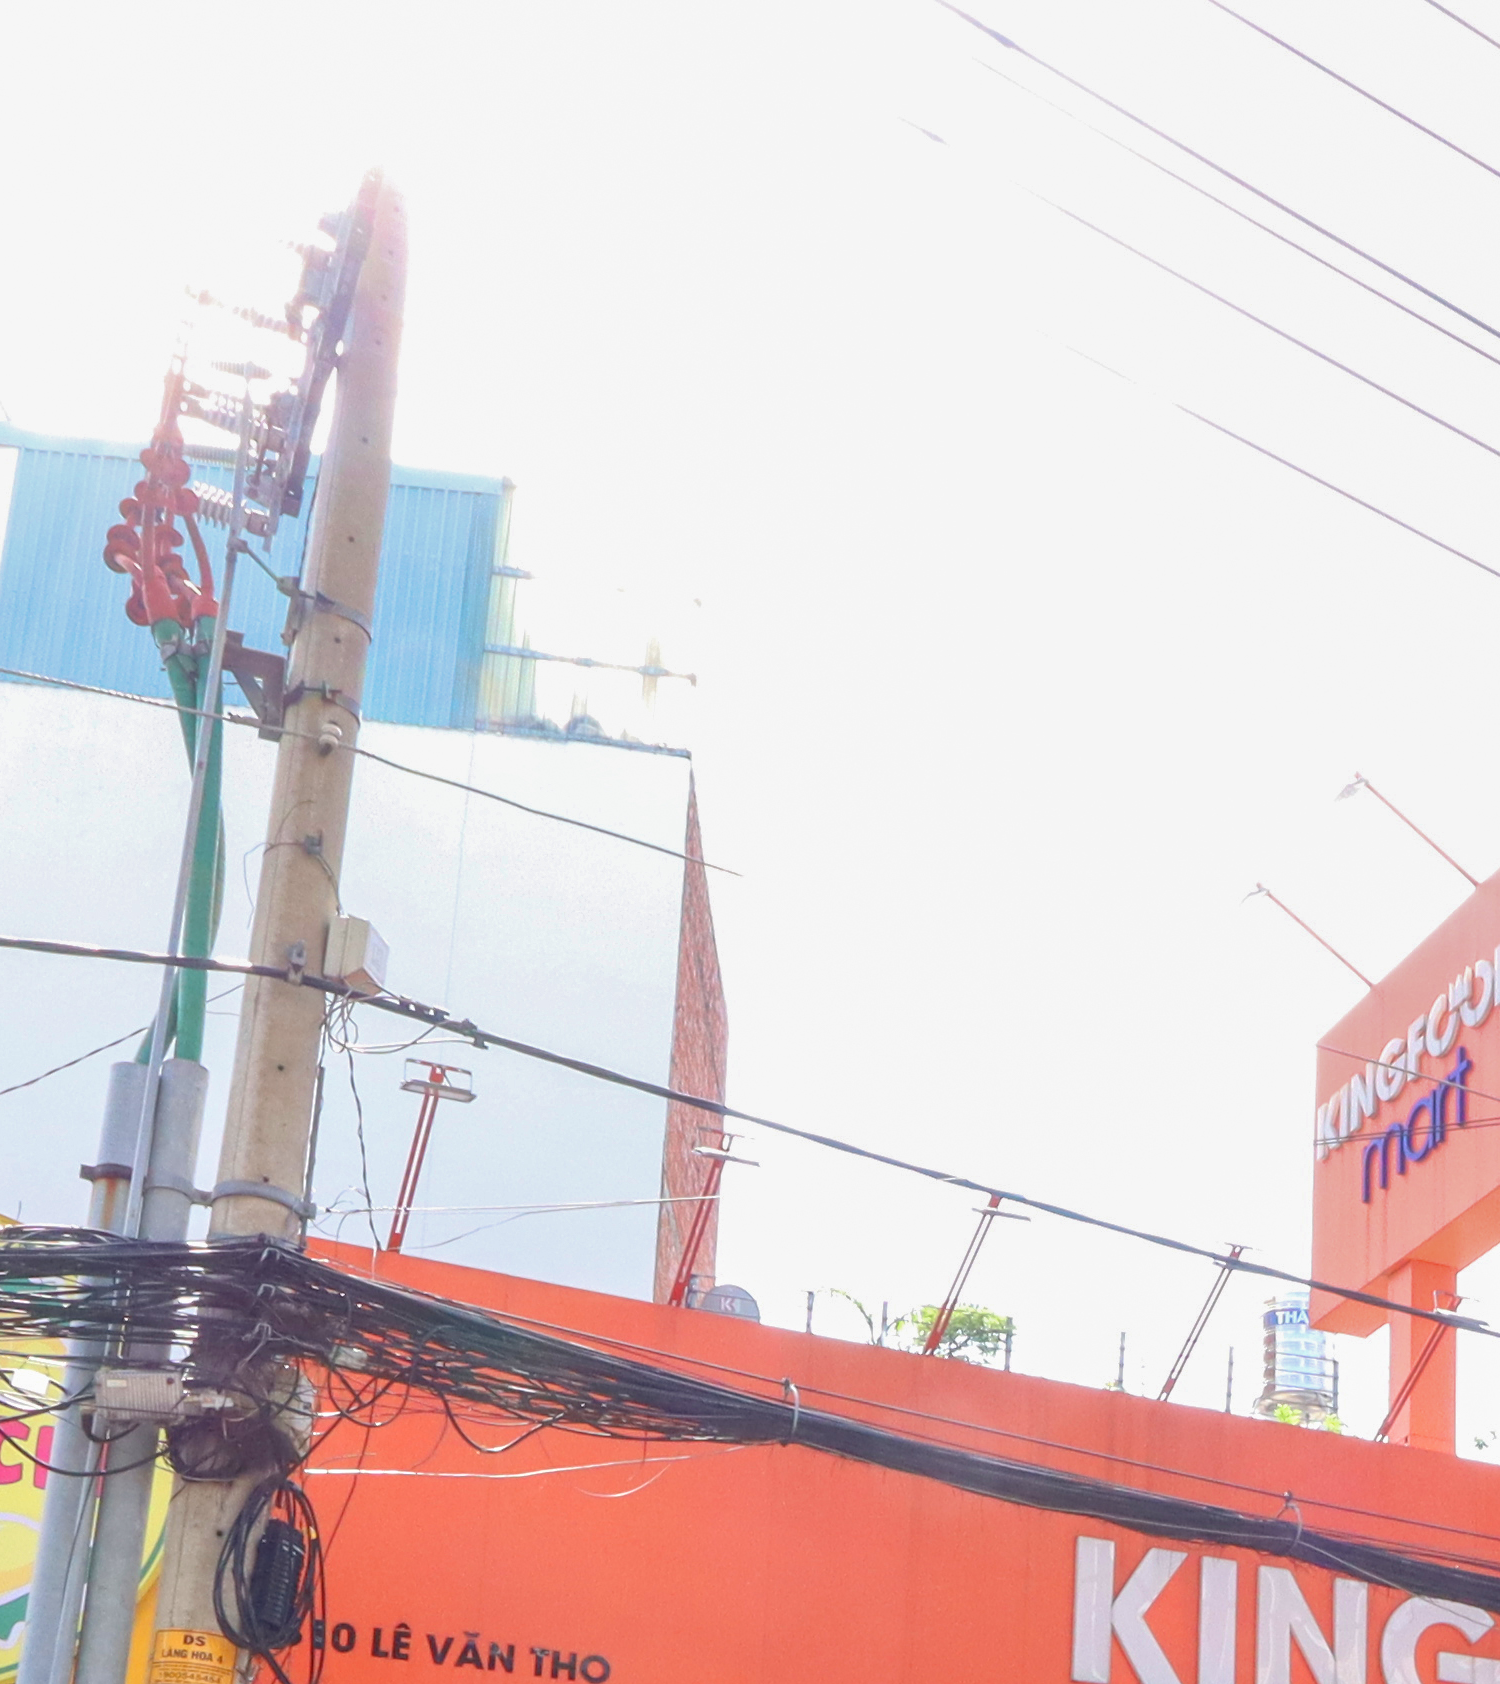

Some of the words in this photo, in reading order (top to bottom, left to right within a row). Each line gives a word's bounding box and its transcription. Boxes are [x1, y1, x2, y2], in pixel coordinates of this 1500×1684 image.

[1362, 1046, 1473, 1203] mart
[183, 1634, 206, 1647] DS
[372, 1623, 411, 1661] LÊ
[426, 1631, 515, 1674] VĂN
